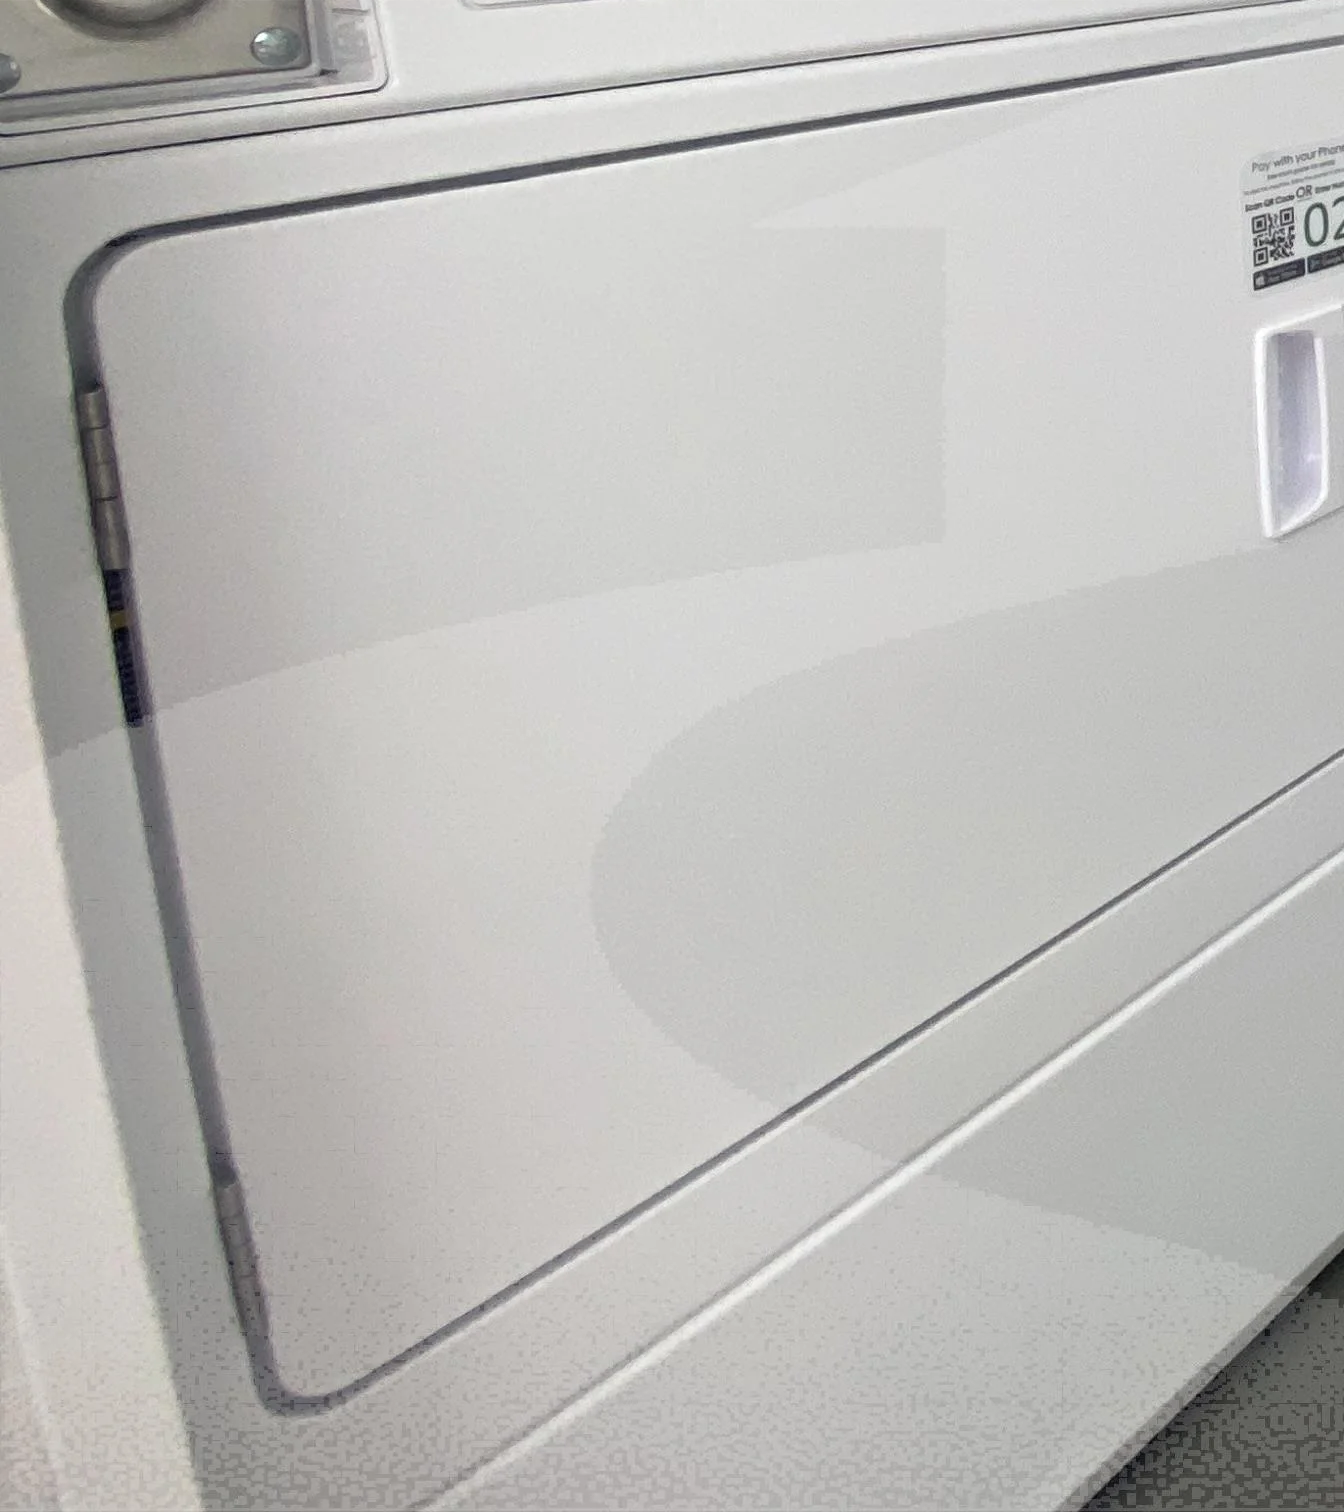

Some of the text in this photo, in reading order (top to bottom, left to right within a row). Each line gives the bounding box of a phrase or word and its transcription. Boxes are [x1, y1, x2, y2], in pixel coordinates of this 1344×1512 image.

[1252, 161, 1270, 173] Pay
[1274, 154, 1294, 167] with
[1295, 151, 1316, 164] your
[1245, 200, 1263, 212] Scan
[1264, 198, 1274, 207] QR
[1275, 194, 1295, 205] Code
[1296, 185, 1313, 199] OR
